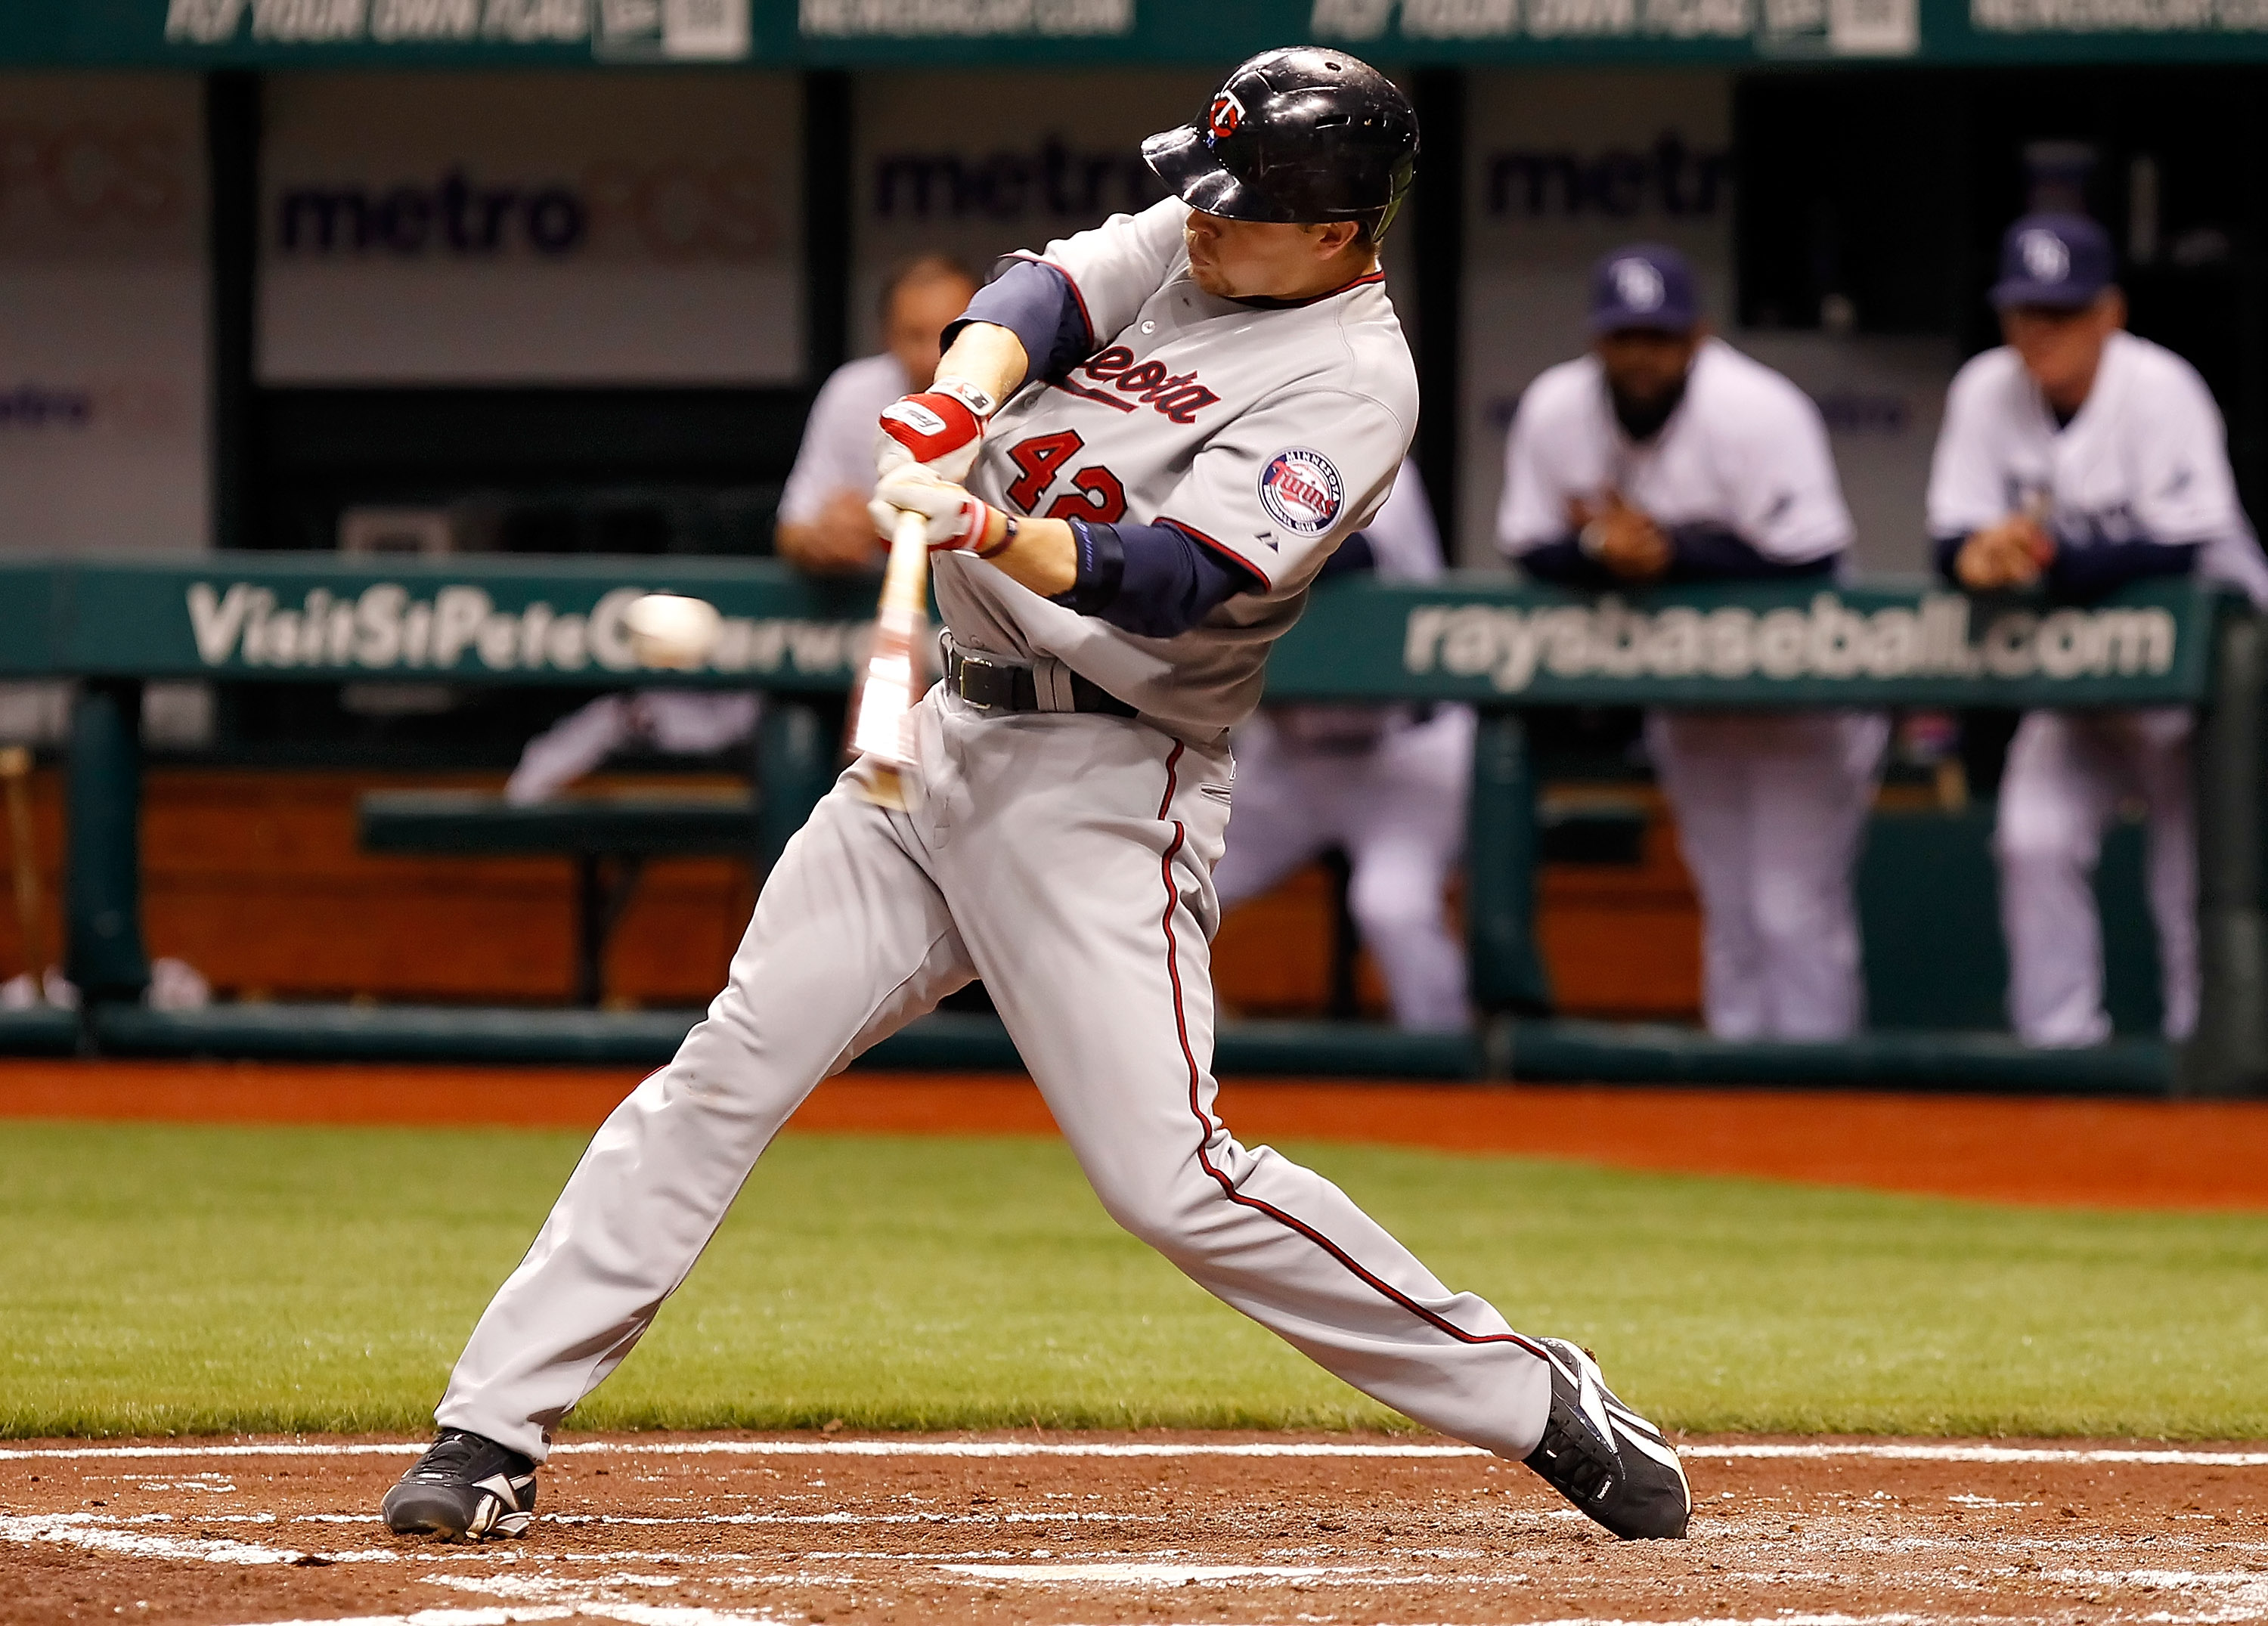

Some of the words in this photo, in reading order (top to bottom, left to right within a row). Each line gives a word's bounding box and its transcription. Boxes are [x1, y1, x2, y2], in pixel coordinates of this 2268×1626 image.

[1006, 429, 1128, 523] 42
[1269, 460, 1337, 519] Twins
[1285, 451, 1341, 502] MINNESOTA
[1405, 594, 2175, 691] raysbaseball.com
